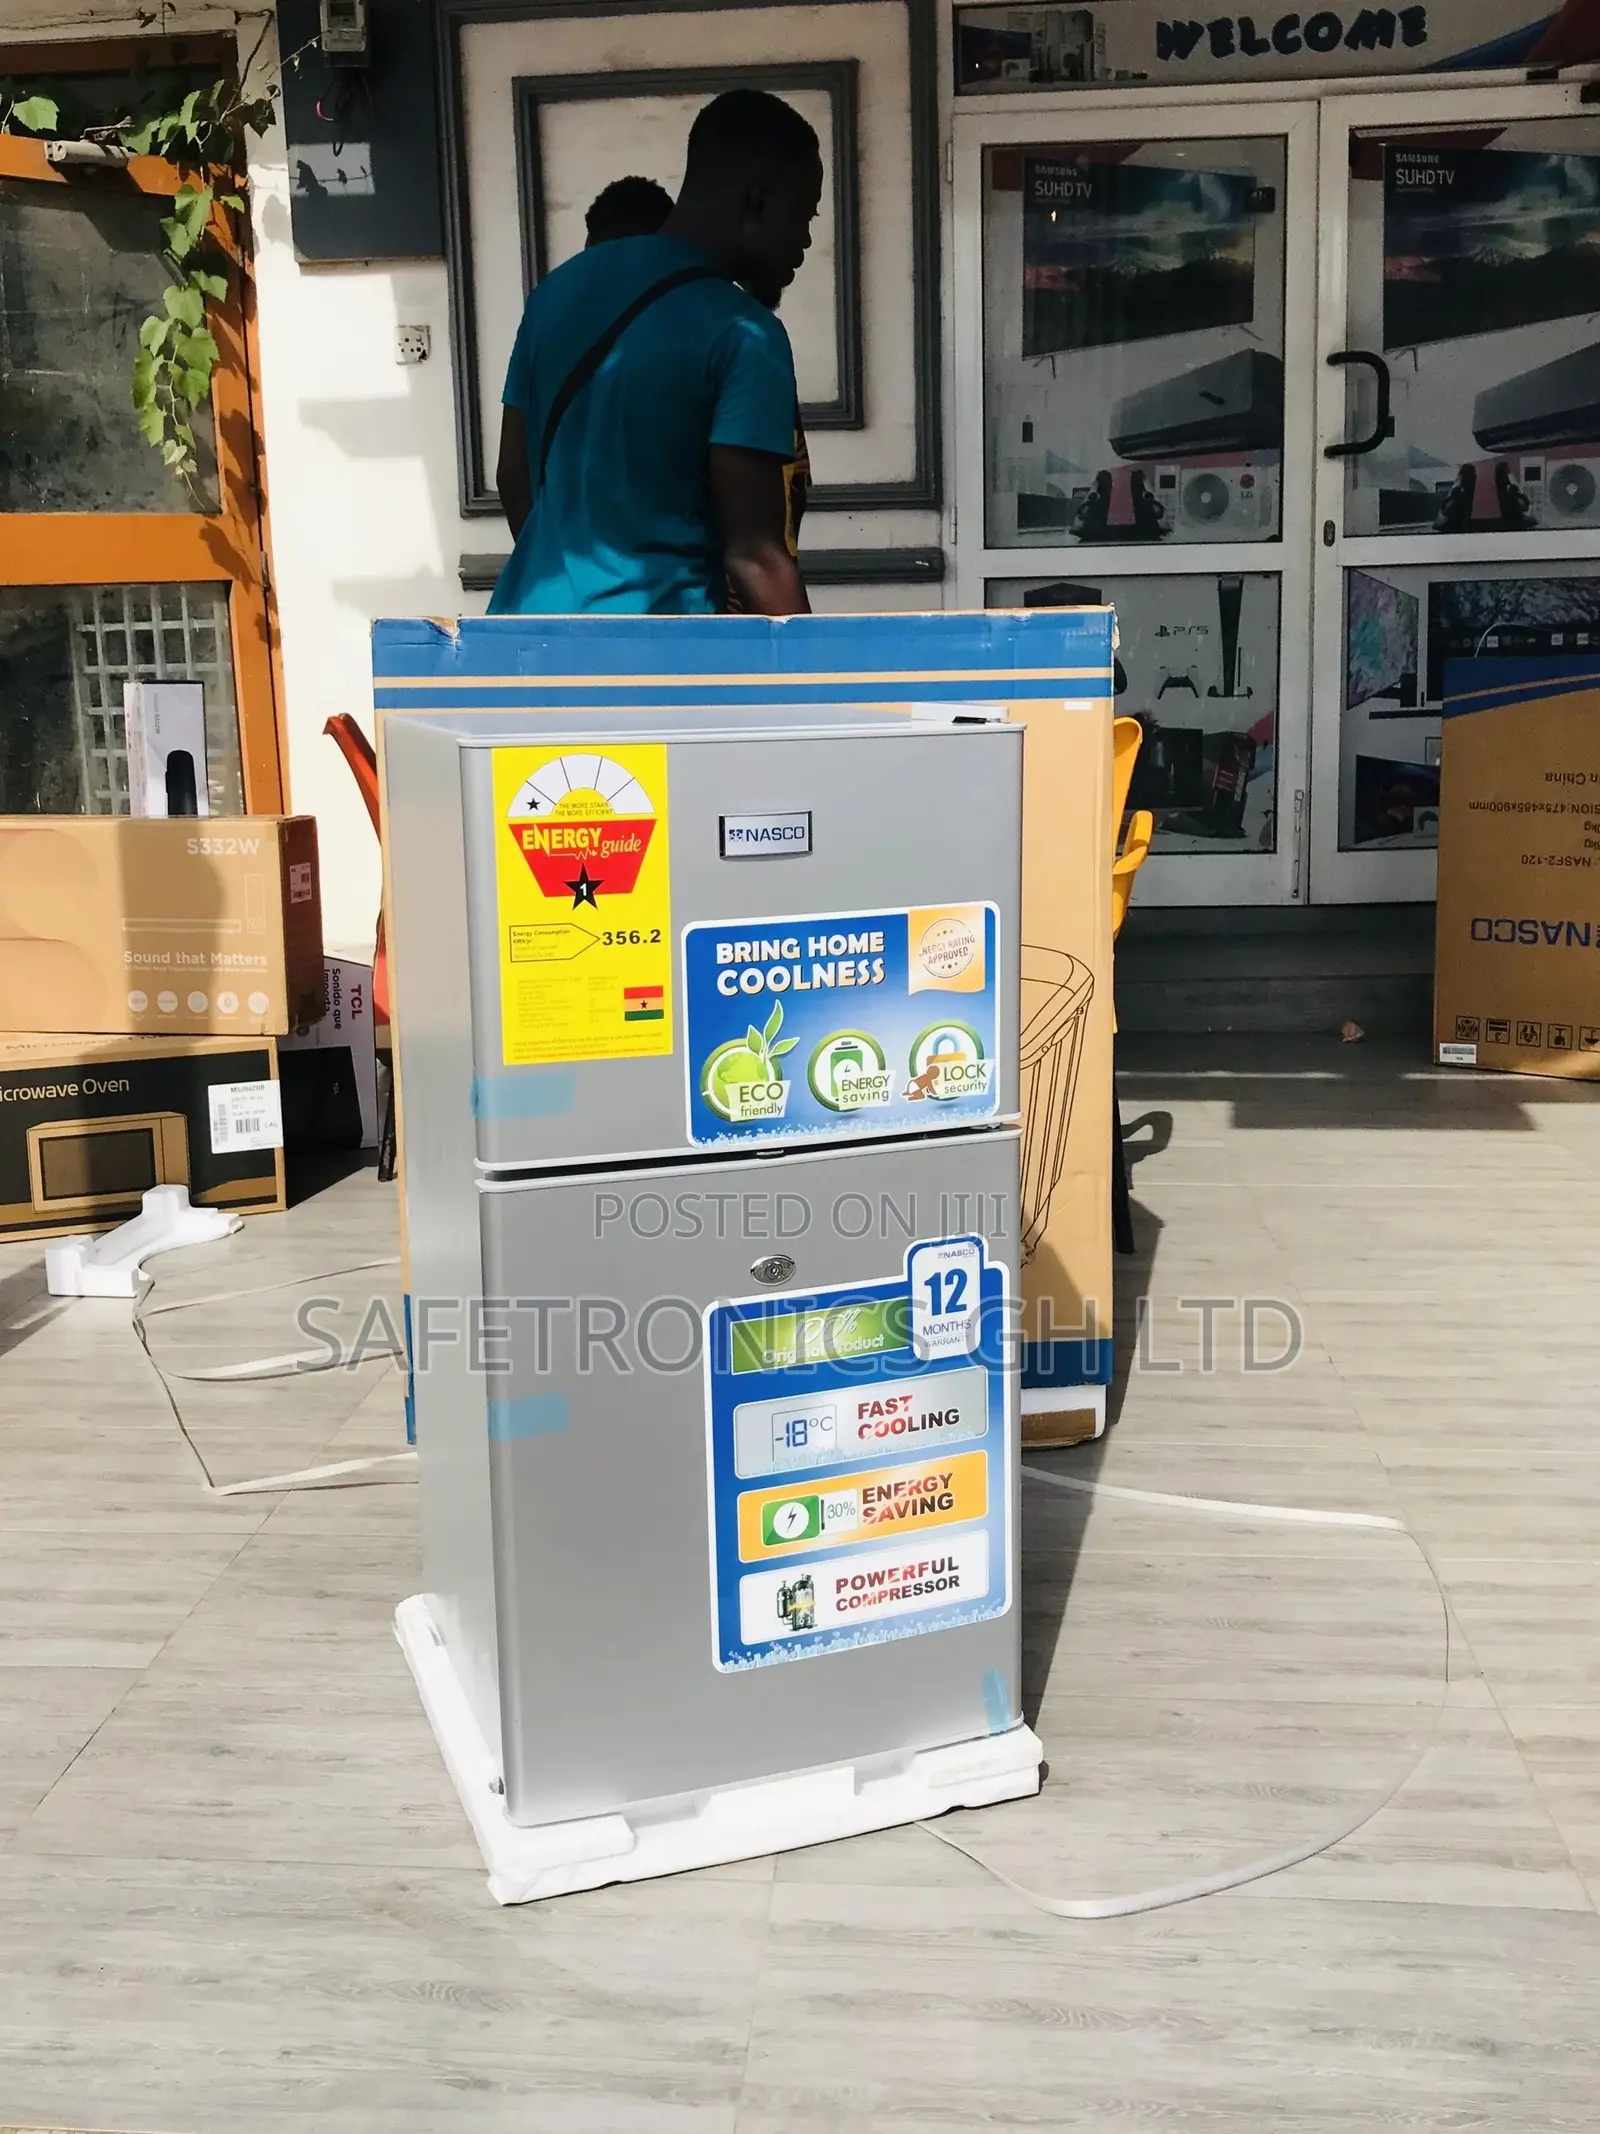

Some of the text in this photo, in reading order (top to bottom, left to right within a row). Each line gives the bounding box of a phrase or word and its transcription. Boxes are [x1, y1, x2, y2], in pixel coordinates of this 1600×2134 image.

[1155, 5, 1428, 61] WELCOME
[1395, 152, 1440, 164] SAMSUNG
[1034, 164, 1078, 176] SAMSUNG
[1545, 772, 1587, 786] China
[521, 823, 642, 858] ENERGY guide
[745, 825, 805, 842] NASCO
[186, 837, 260, 856] S332W
[1521, 854, 1591, 868] NASF2-120
[580, 883, 588, 896] 1
[601, 929, 662, 946] 356.2
[1470, 918, 1591, 947] NASCO
[716, 930, 886, 965] BRING HOME
[919, 935, 976, 956] NERGY RATING
[124, 951, 268, 966] Sound that Matters
[928, 946, 969, 965] APPROVED
[716, 958, 887, 997] COOLNESS
[331, 968, 343, 1030] Sonido que
[350, 984, 363, 1020] TCL
[944, 1063, 987, 1082] LOCK
[82, 1078, 130, 1095] Oven
[739, 1082, 784, 1103] ECO
[842, 1074, 891, 1092] ENERGY
[944, 1079, 988, 1094] security
[842, 1089, 890, 1104] saving
[740, 1102, 784, 1120] friendly
[943, 1248, 976, 1259] NASCO
[924, 1268, 968, 1317] 12
[922, 1320, 972, 1336] MONTHS
[761, 1333, 885, 1363] Origal roduct
[857, 1393, 915, 1421] FAST
[857, 1408, 961, 1441] COOLING
[862, 1472, 954, 1505] ENERGY
[826, 1500, 857, 1520] 30%
[862, 1491, 954, 1525] SAVING
[835, 1555, 960, 1596] POWERFUL
[835, 1574, 961, 1613] COMPRESSOR
